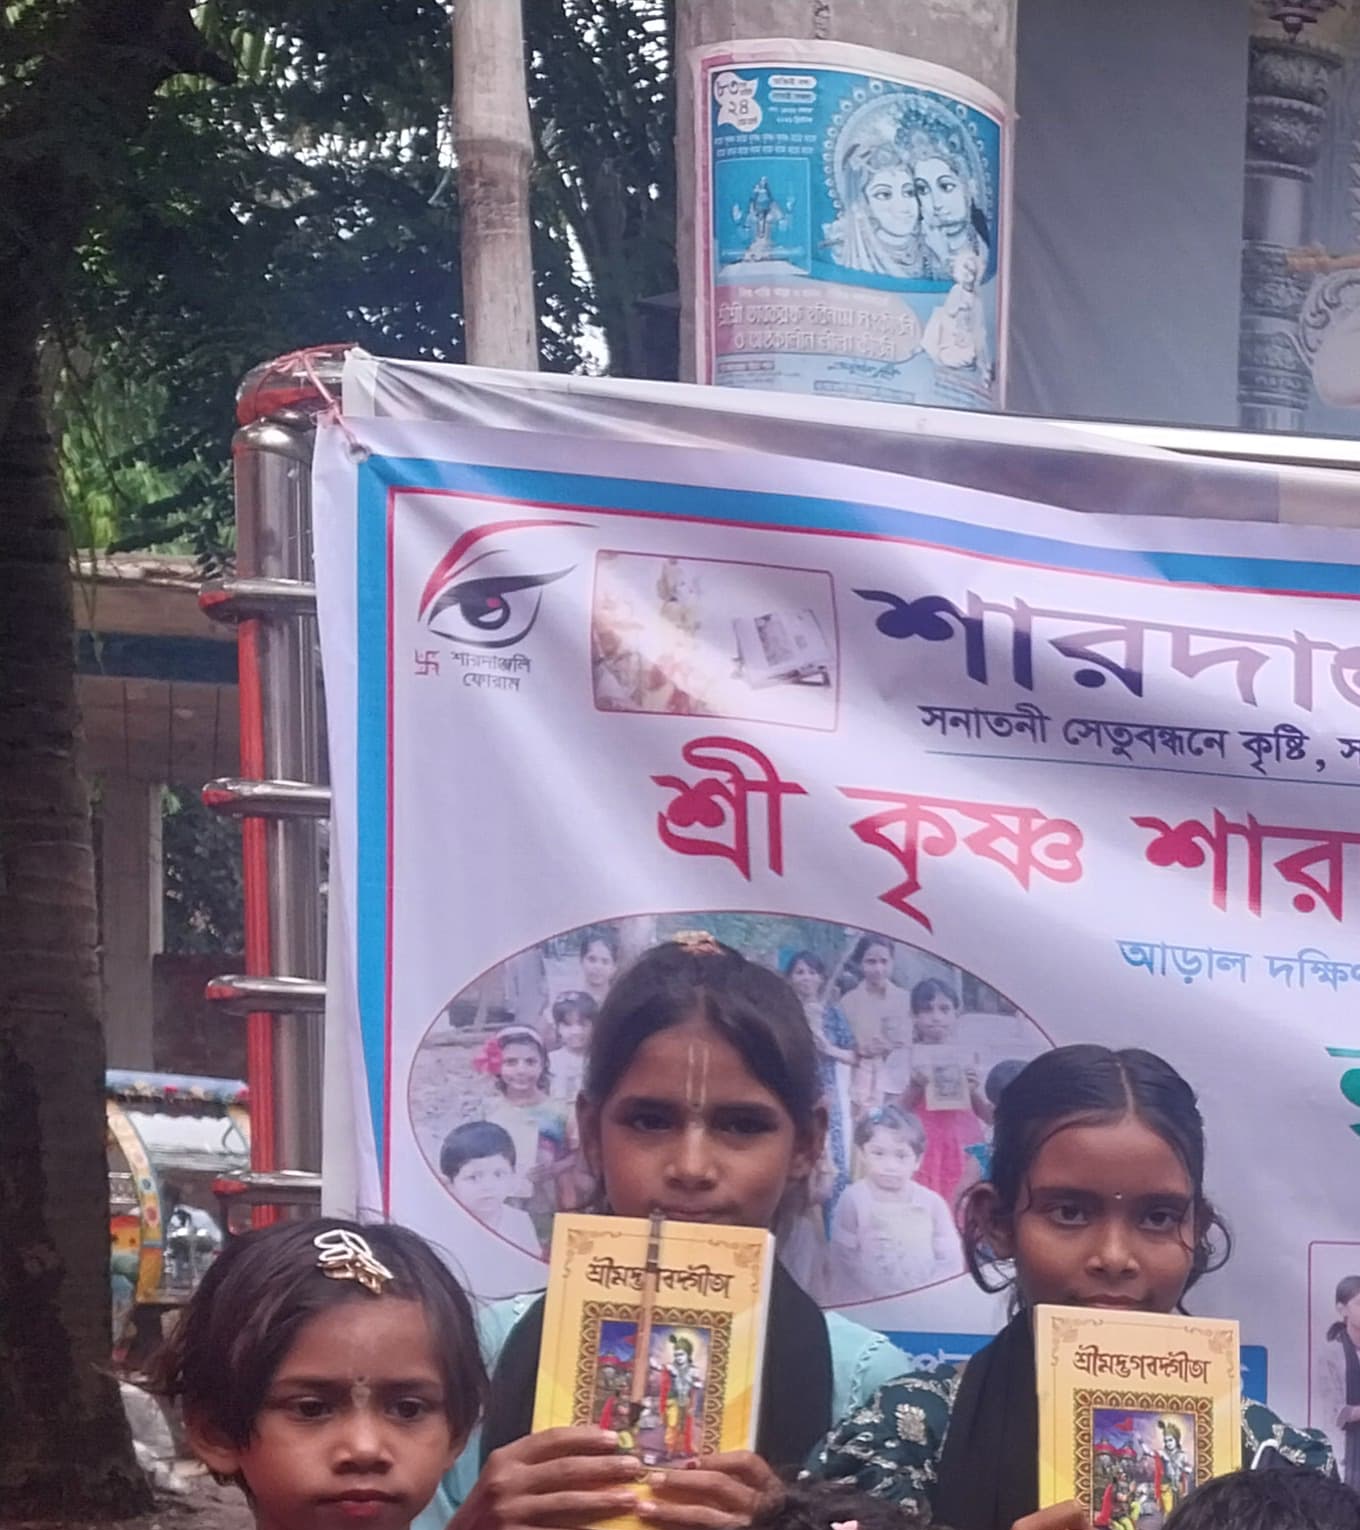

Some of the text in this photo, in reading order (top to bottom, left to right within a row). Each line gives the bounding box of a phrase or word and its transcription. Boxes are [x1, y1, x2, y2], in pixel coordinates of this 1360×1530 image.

[450, 651, 531, 673] শারদাঞ্জলি
[463, 672, 521, 692] ফোরাম
[919, 703, 1049, 745] সনাতনী
[1062, 713, 1228, 760] সেতুবন্ধনে
[650, 735, 807, 880] শ্রী
[839, 783, 1084, 933] কৃষ্ণ
[1116, 941, 1250, 985] আড়াল
